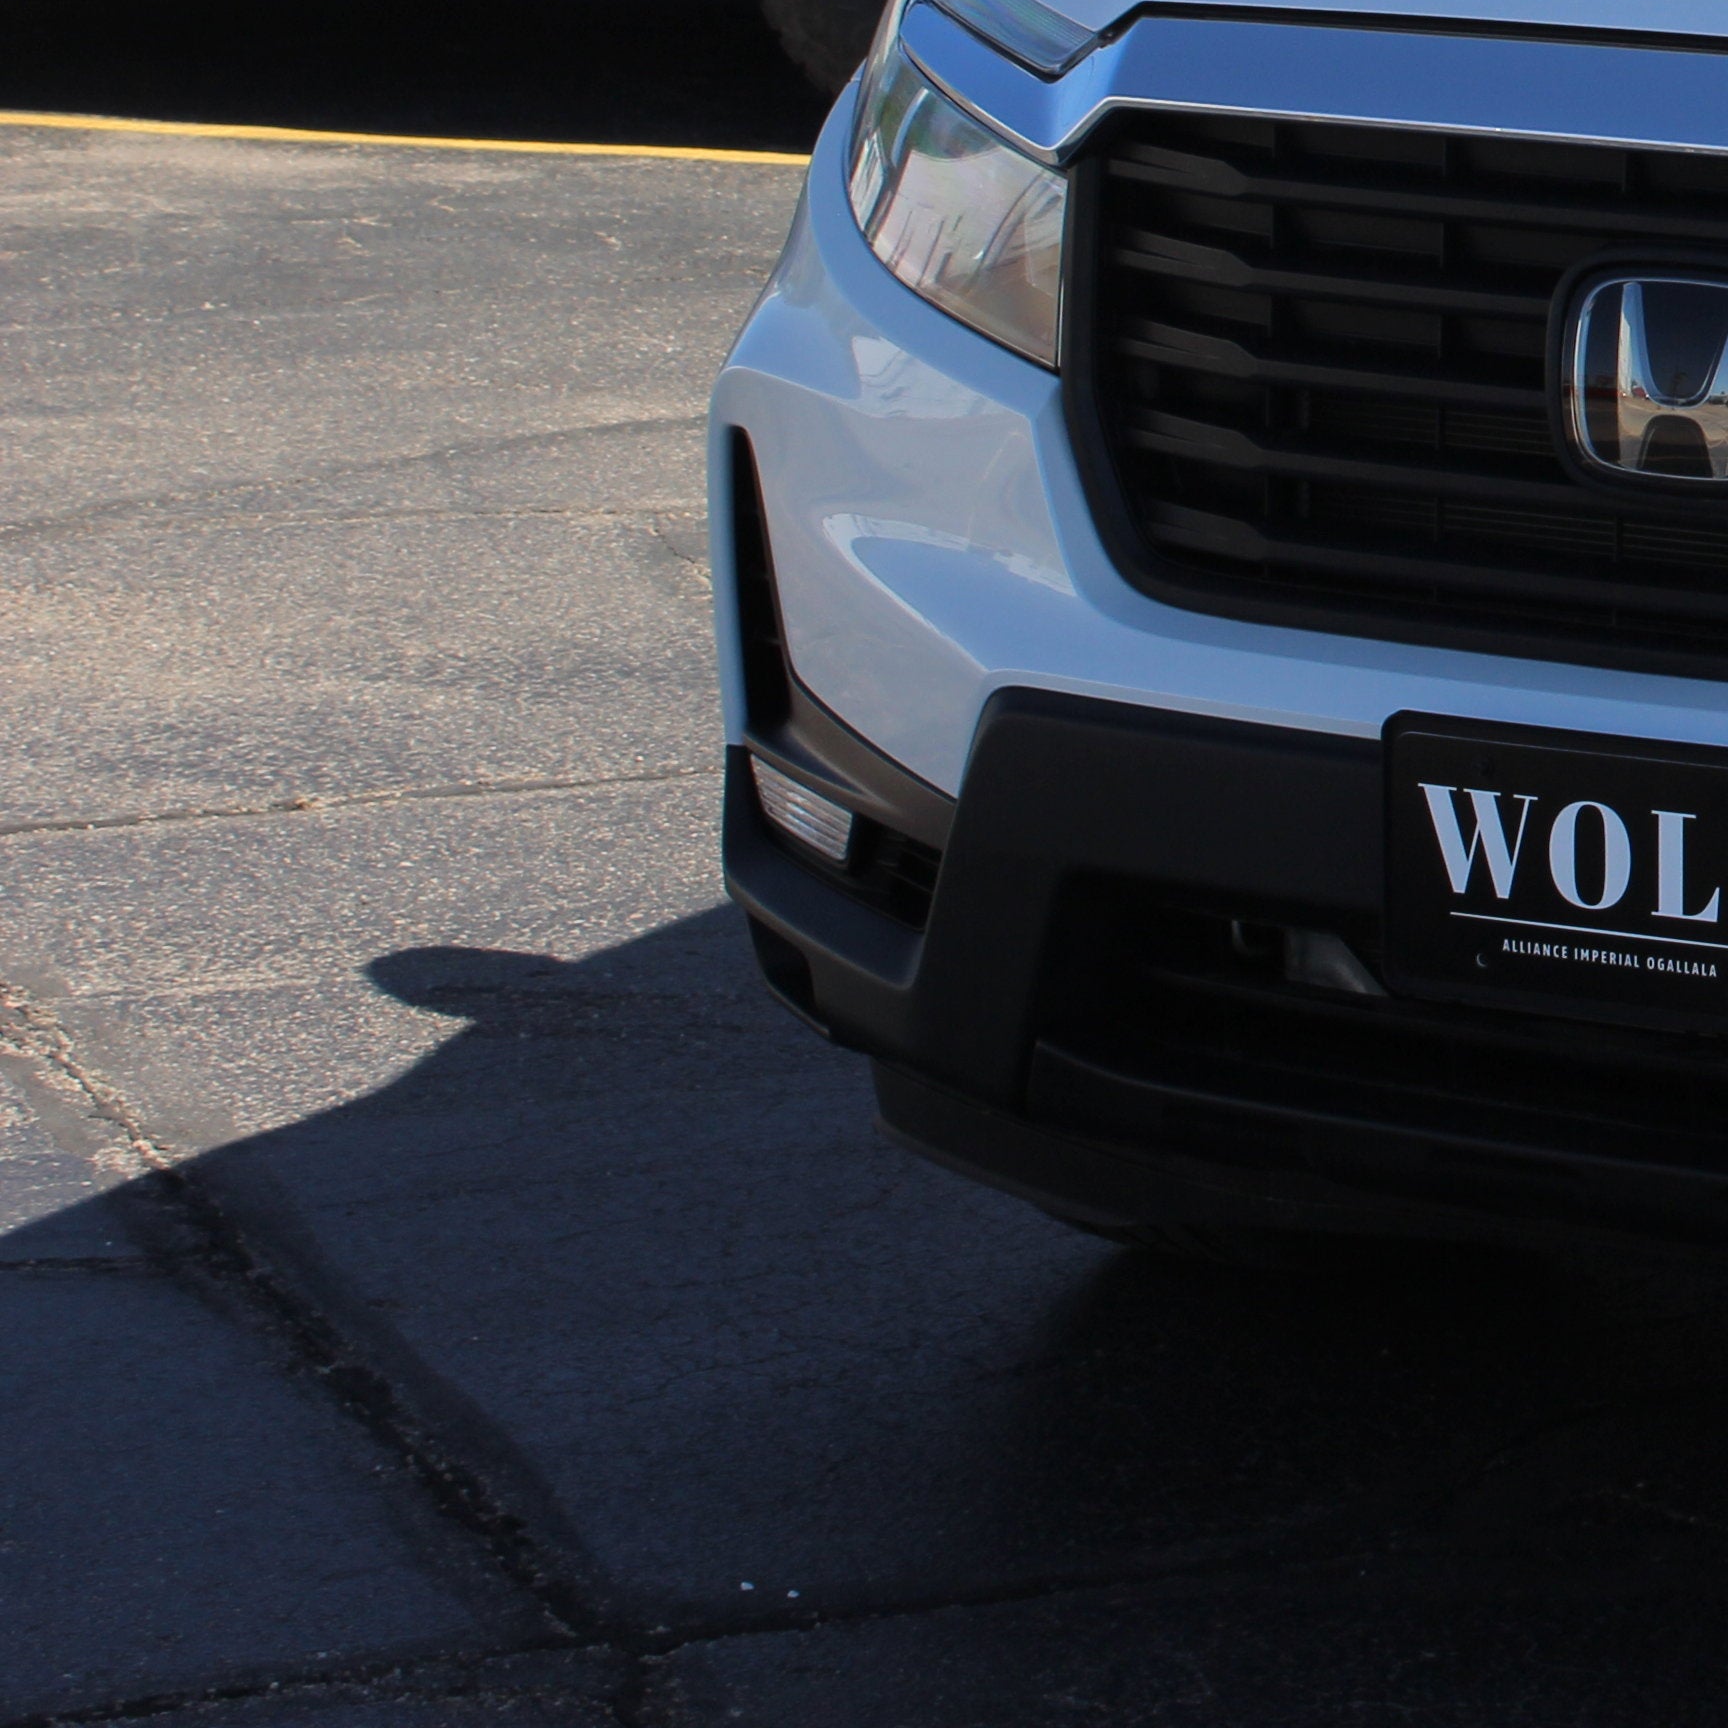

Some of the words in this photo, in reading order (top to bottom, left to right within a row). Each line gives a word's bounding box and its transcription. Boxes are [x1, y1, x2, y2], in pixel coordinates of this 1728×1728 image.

[1502, 939, 1568, 959] ALLIANCE
[1574, 947, 1640, 969] IMPERIAL
[1646, 956, 1718, 977] OGALLALA
